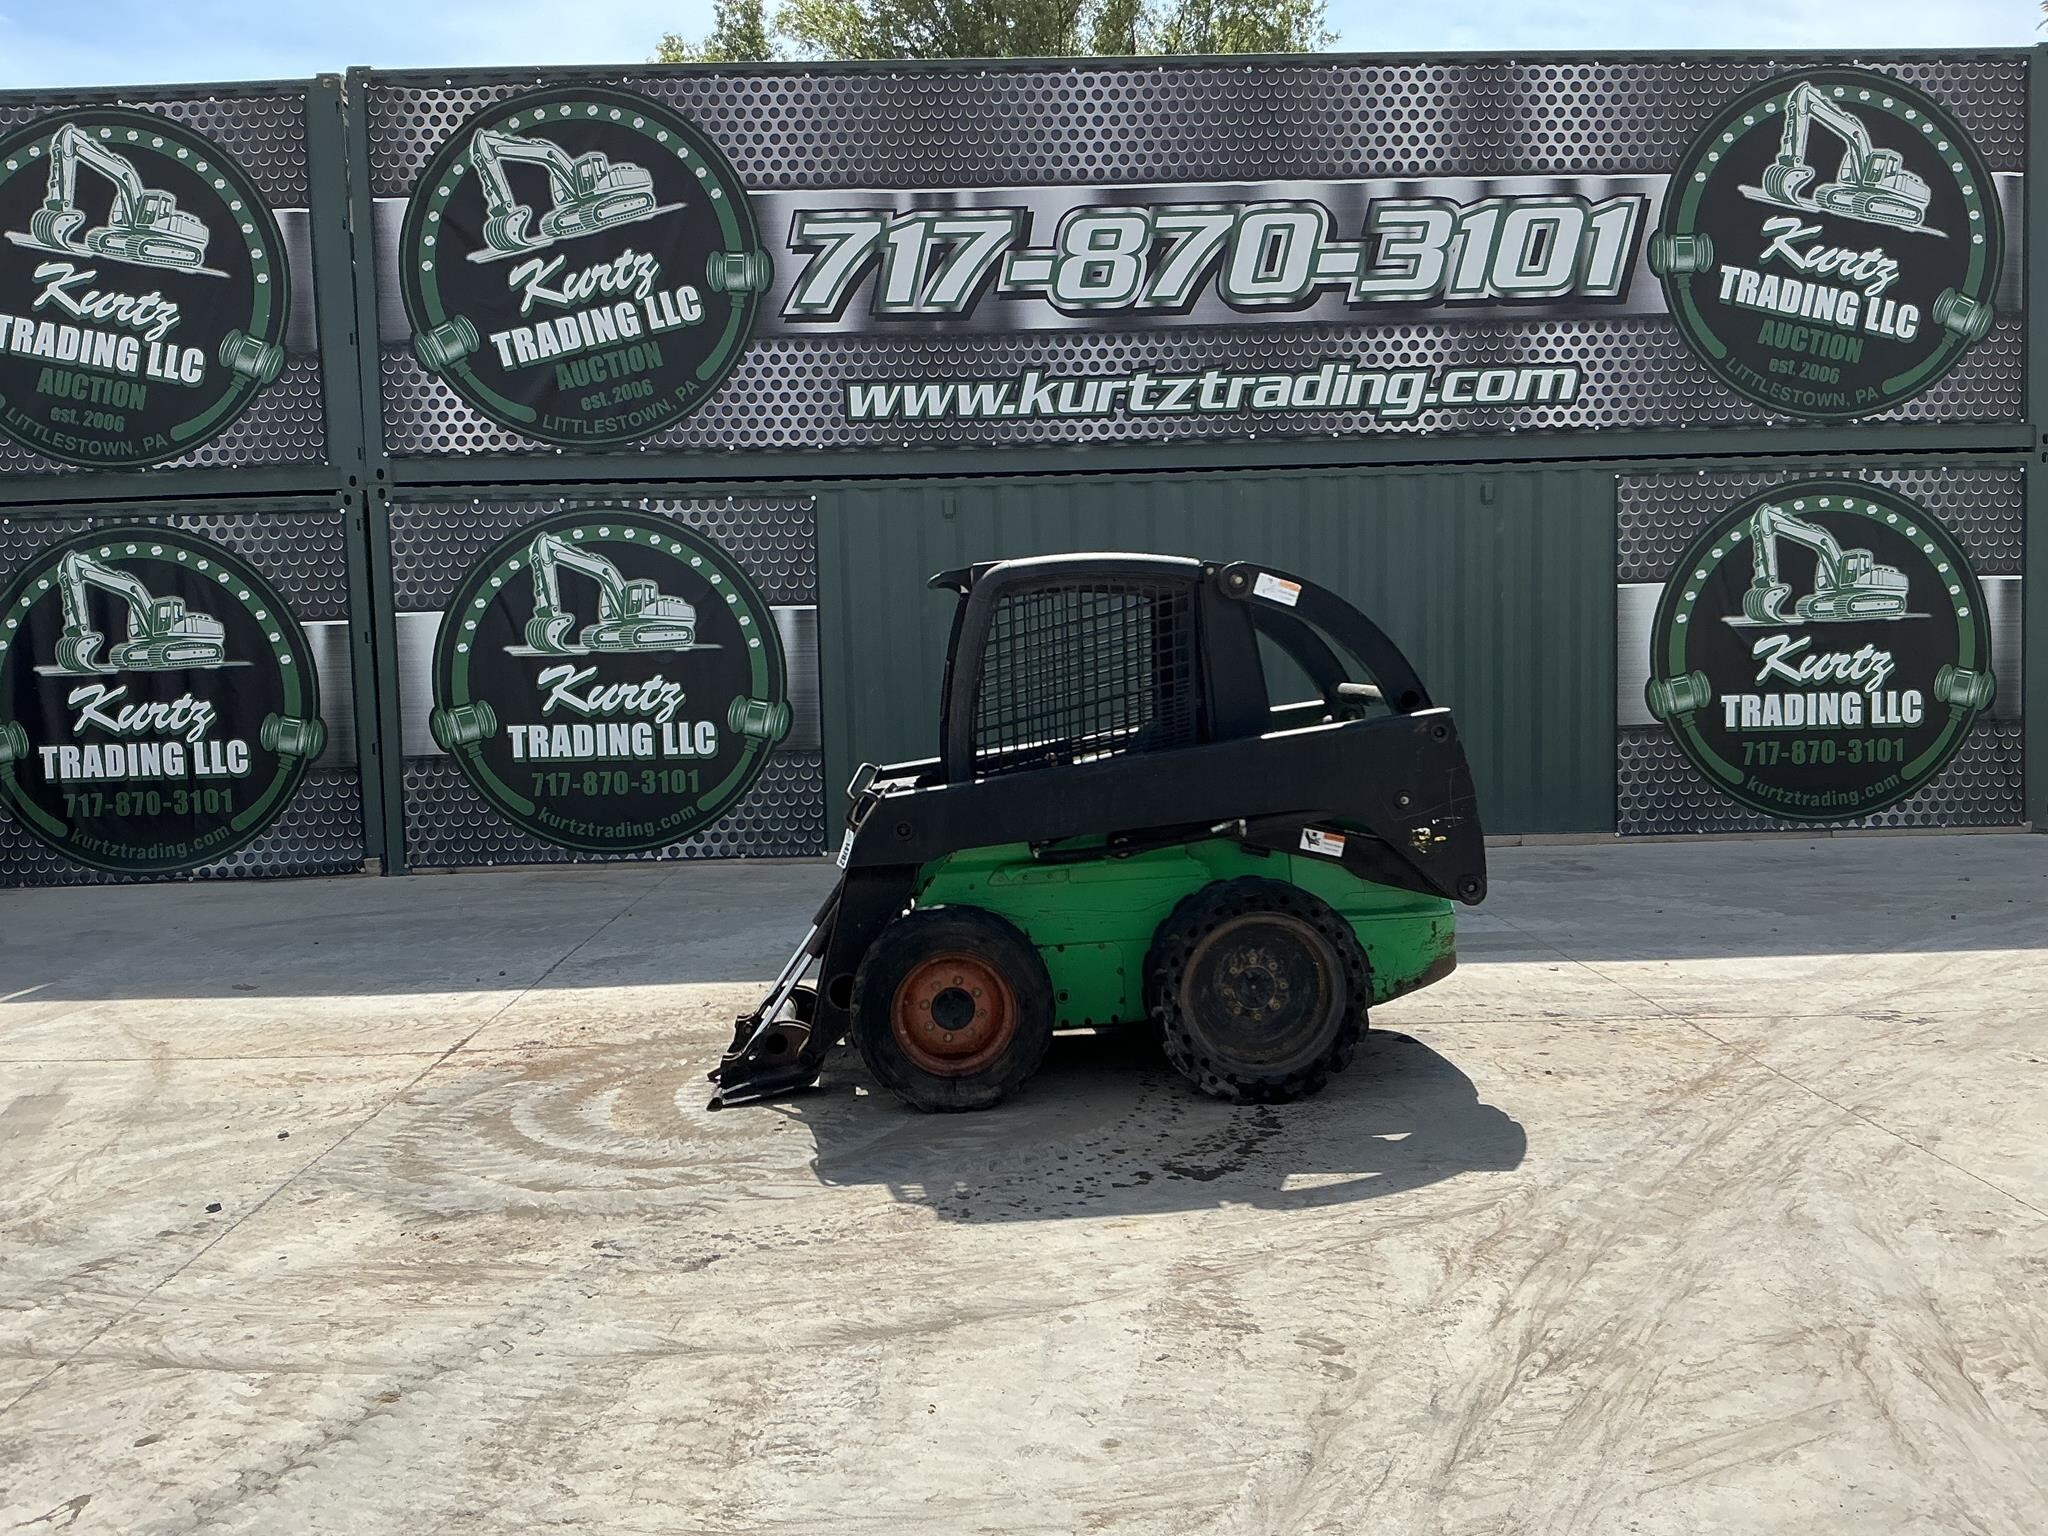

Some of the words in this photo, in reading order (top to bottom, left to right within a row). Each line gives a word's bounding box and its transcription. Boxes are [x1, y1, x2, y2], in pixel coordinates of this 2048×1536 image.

[788, 197, 1641, 315] 717-870-3101
[1759, 216, 1899, 297] Kurtz
[32, 262, 181, 343] Kurtz
[508, 248, 660, 313] Kurtz
[1719, 265, 1860, 327] TRADING
[1864, 296, 1921, 340] LLC
[490, 299, 642, 368] TRADING
[645, 285, 704, 331] LLC
[1757, 319, 1865, 364] AUCTION
[146, 341, 205, 384] LLC
[555, 340, 665, 393] AUCTION
[1726, 356, 1851, 408] LITTLESTOWN,
[1856, 385, 1880, 403] PA
[1768, 356, 1797, 377] est.
[1799, 361, 1841, 385] 2006
[36, 367, 148, 411] AUCTION
[542, 396, 676, 436] LITTLESTOWN,
[677, 380, 700, 403] PA
[580, 388, 611, 412] est.
[612, 378, 655, 404] 2006
[847, 362, 1581, 420] www.kurtztrading.com
[5, 407, 139, 456] LITTLESTOWN,
[143, 433, 169, 450] PA
[50, 405, 80, 426] est.
[82, 409, 126, 433] 2006
[1752, 634, 1896, 692] Kurtz
[67, 684, 217, 743] Kurtz
[537, 664, 685, 723] Kurtz
[1721, 692, 1862, 728] TRADING
[1871, 690, 1924, 725] LLC
[39, 742, 186, 780] TRADING
[195, 740, 251, 778] LLC
[508, 723, 654, 759] TRADING
[663, 721, 718, 756] LLC
[1742, 738, 1904, 766] 717-870-3101
[63, 788, 234, 818] 717-870-3101
[531, 768, 700, 798] 717-870-3101
[1746, 773, 1900, 808] kurtztrading.com
[71, 823, 231, 860] kurtztrading.com
[537, 804, 697, 839] kurtztrading.com
